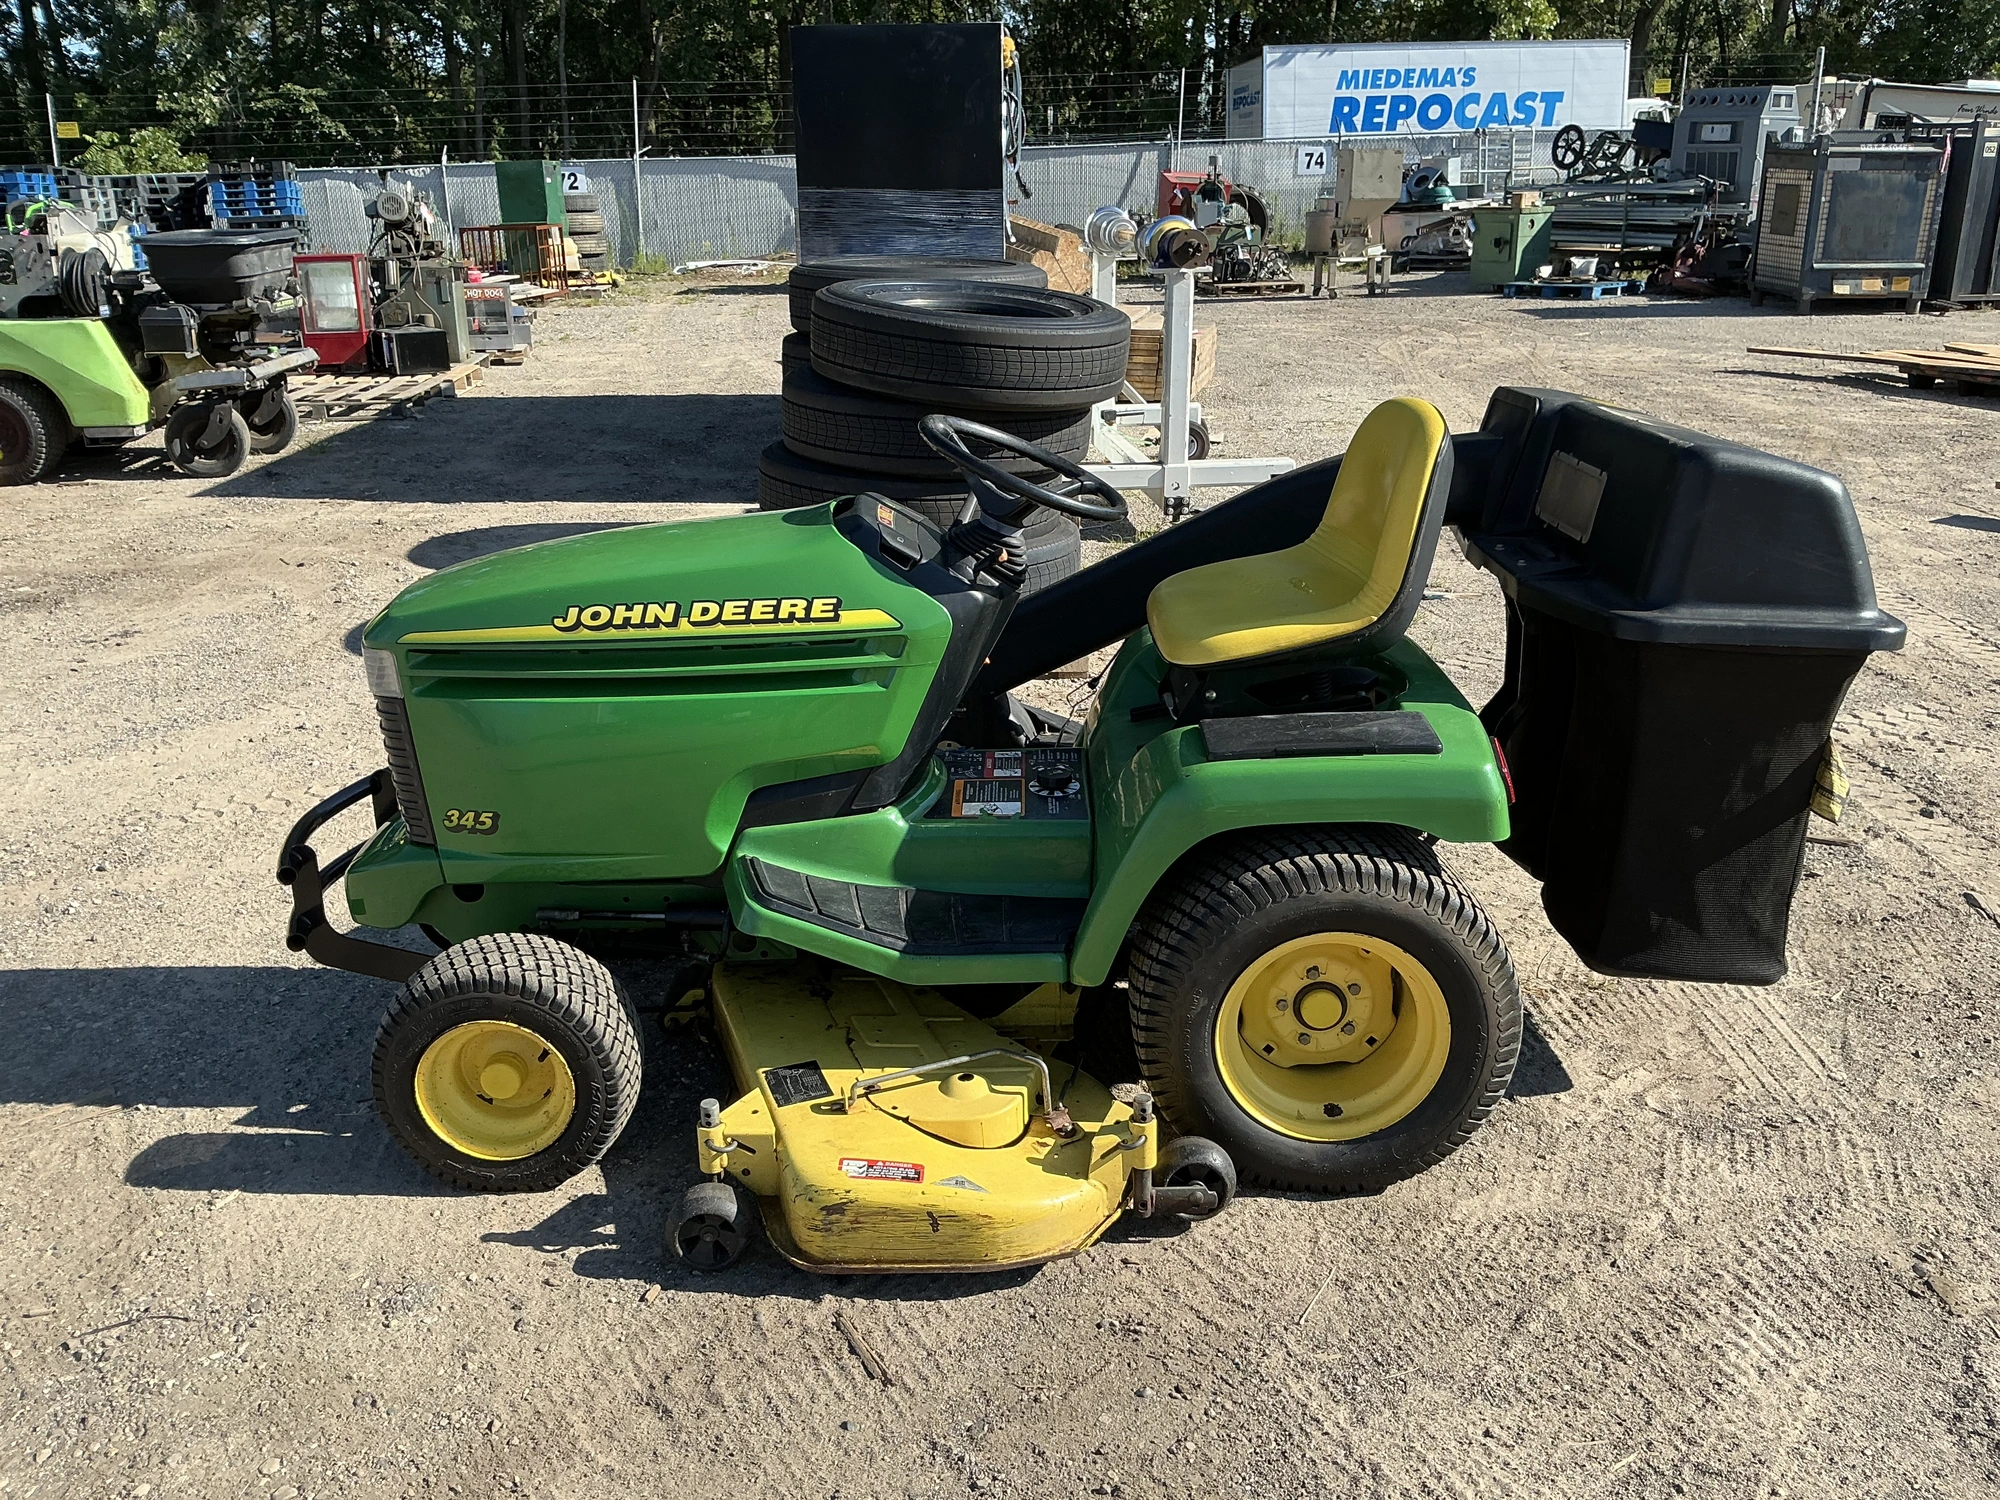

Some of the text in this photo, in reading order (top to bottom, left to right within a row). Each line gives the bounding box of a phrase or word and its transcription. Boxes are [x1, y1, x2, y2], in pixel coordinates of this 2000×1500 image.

[1336, 67, 1477, 90] MIEDEMA'S
[1328, 91, 1565, 133] REPOCAST
[1304, 152, 1325, 170] 74
[466, 289, 504, 298] HOT DOGS
[553, 597, 842, 631] JOHN DEERE
[443, 809, 497, 832] 345
